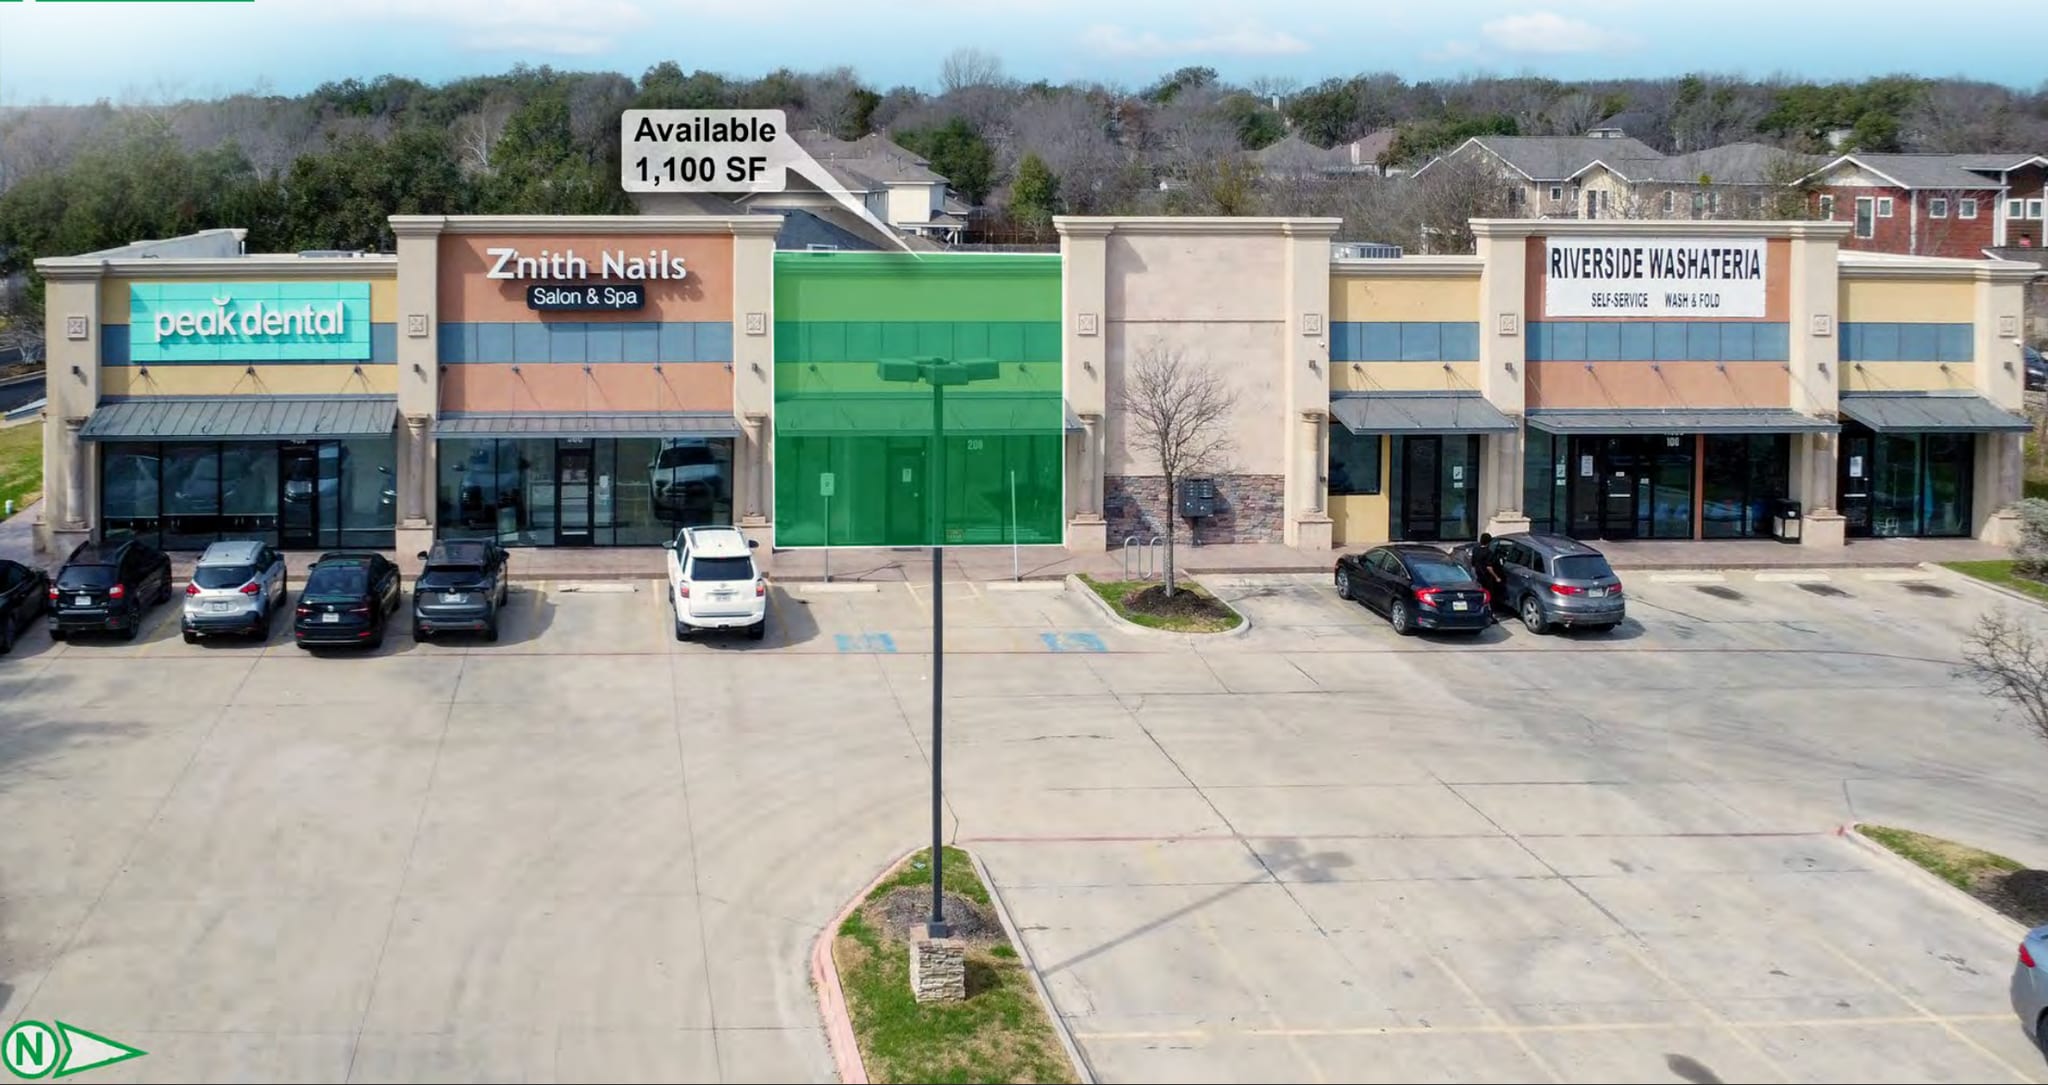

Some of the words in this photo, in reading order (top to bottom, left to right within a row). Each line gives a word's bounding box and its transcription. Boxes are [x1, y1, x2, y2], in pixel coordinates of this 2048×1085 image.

[602, 249, 687, 280] Nails
[1551, 247, 1643, 279] RIVERSIDE
[1649, 248, 1761, 279] WASHATERIA
[533, 287, 581, 305] Salon
[586, 287, 600, 305] &
[603, 287, 638, 308] Spa
[1591, 292, 1648, 308] SELF-SERVICE
[1665, 293, 1689, 308] WASH
[1691, 294, 1697, 308] &
[1699, 293, 1720, 308] FOLD
[154, 296, 237, 343] peak
[241, 301, 345, 336] dental
